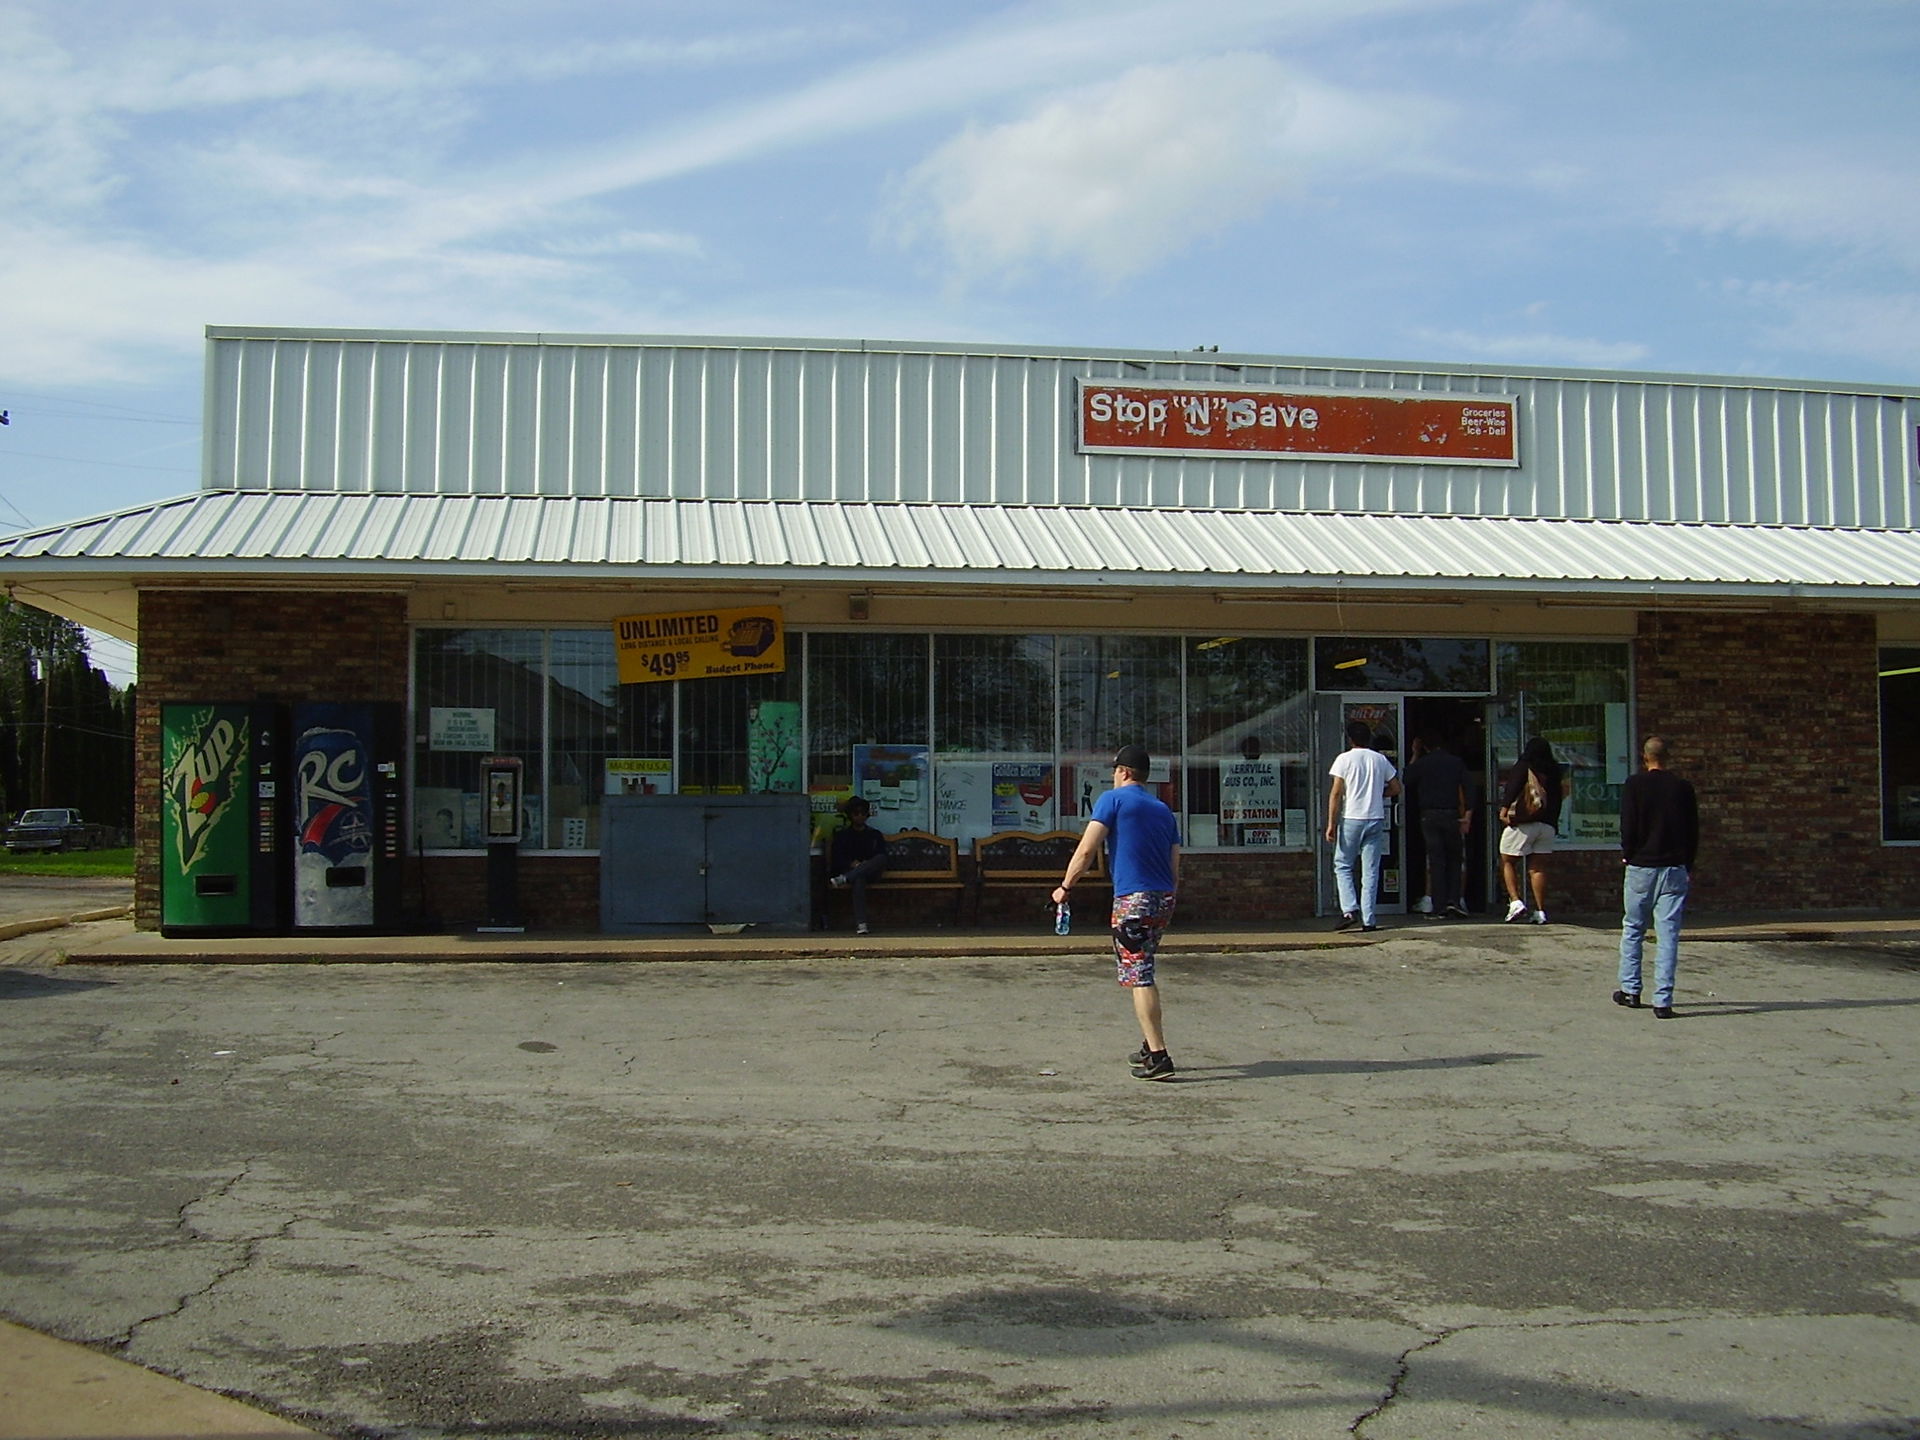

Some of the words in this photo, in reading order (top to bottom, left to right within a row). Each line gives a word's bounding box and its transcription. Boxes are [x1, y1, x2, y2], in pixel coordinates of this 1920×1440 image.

[1090, 393, 1168, 431] Stop
[1238, 399, 1319, 430] Save
[1462, 407, 1506, 417] Groceries
[1461, 416, 1506, 426] Beer-Wine
[619, 615, 719, 640] UNLIMITED
[638, 638, 666, 648] DISTANCE
[705, 663, 741, 674] Budget
[743, 661, 775, 671] Phone
[610, 761, 635, 771] MADE
[636, 761, 645, 770] IN
[1224, 776, 1241, 787] BUS
[1259, 776, 1277, 787] INC.
[298, 750, 364, 828] RC
[1223, 808, 1240, 819] BUS
[1242, 808, 1278, 819] STATION
[1252, 830, 1271, 838] OPEN
